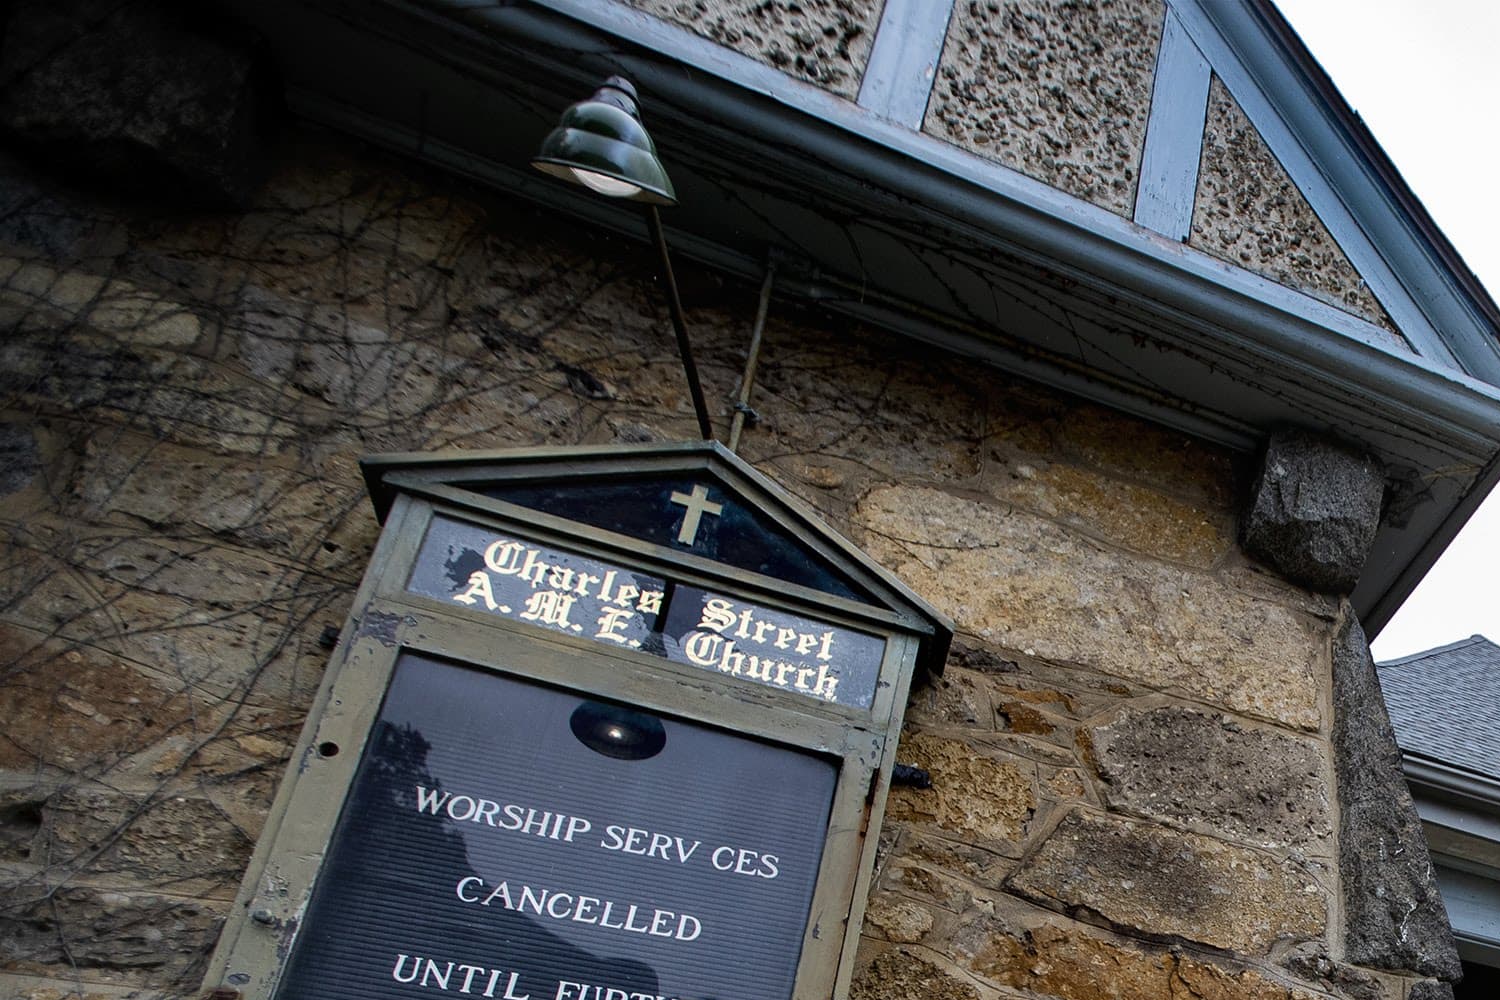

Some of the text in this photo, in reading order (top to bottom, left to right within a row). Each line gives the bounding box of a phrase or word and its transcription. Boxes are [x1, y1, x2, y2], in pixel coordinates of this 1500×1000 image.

[484, 540, 834, 661] Charles Street
[685, 631, 839, 701] Church
[416, 786, 591, 843] WORSHIP
[456, 876, 702, 941] CANCELLED
